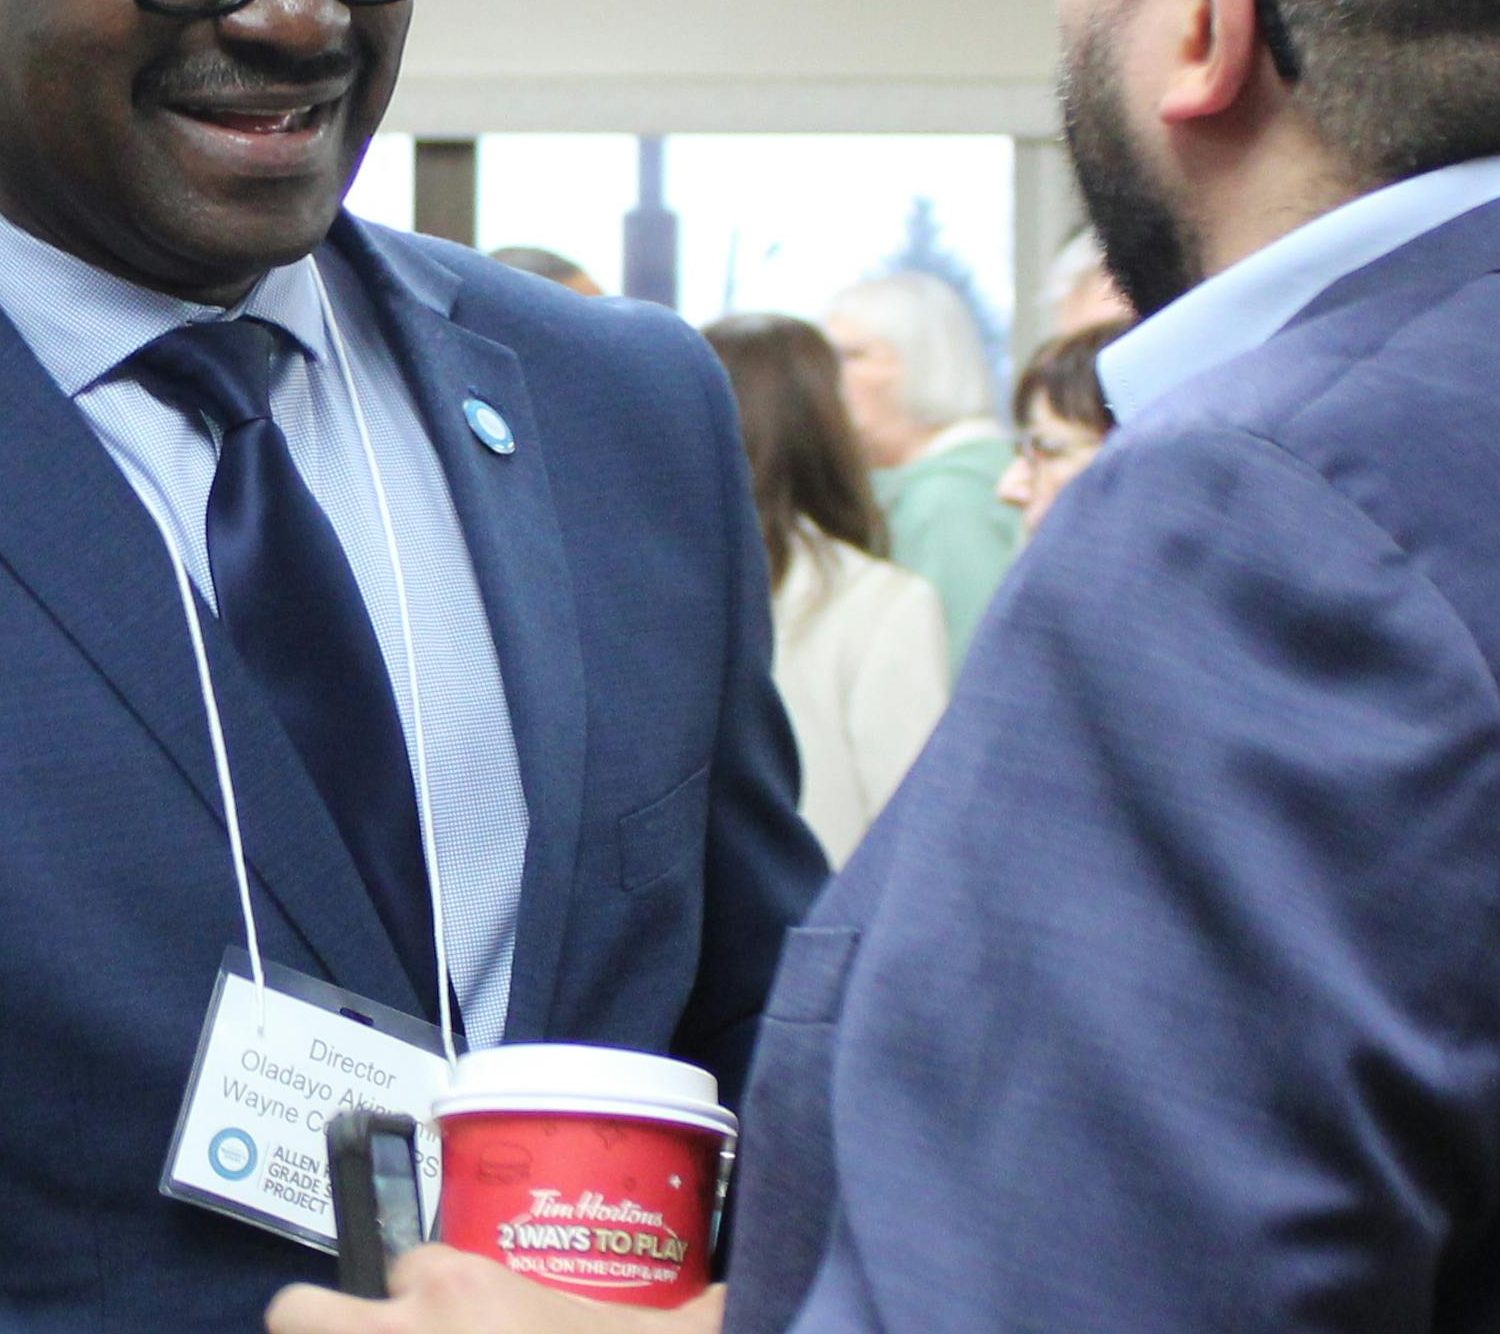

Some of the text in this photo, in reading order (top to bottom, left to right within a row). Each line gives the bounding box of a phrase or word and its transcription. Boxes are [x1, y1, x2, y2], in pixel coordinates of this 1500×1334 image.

[241, 1049, 332, 1101] Oladayo
[309, 1039, 396, 1089] Director
[223, 1075, 298, 1124] Wayne
[268, 1162, 321, 1194] GRADE
[273, 1146, 320, 1174] ALLEN
[264, 1178, 329, 1215] PROJECT
[529, 1189, 663, 1227] Tim Hortons
[498, 1223, 689, 1263] 2 WAYS TO PLAY
[510, 1256, 547, 1273] ROLL
[550, 1257, 576, 1273] ON
[578, 1260, 606, 1276] THE
